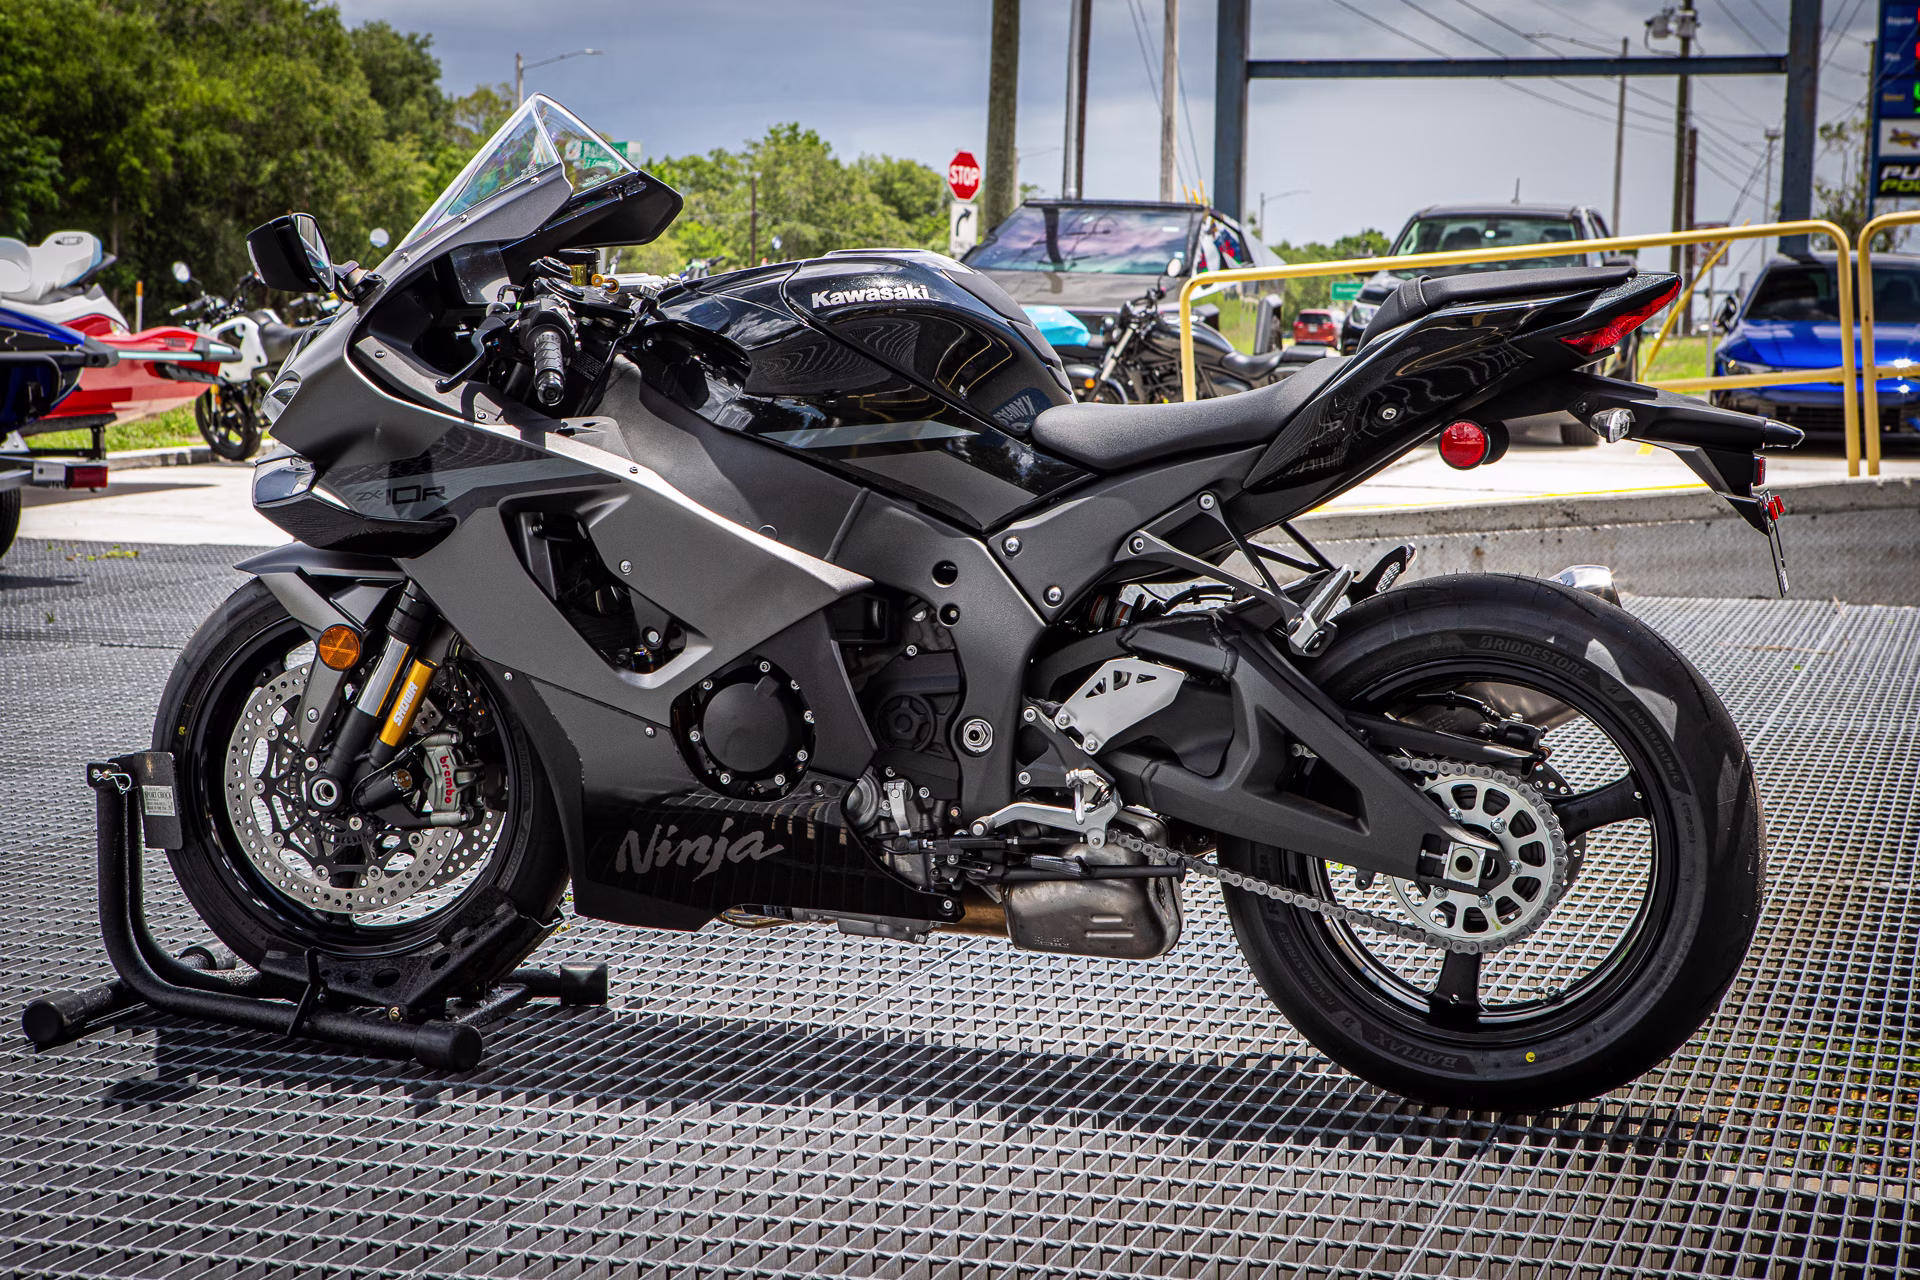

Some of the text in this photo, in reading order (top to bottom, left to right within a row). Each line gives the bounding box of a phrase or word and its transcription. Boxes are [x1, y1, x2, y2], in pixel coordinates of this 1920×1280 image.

[950, 164, 979, 187] STOP
[811, 284, 930, 309] Kawasaki
[355, 485, 448, 506] ZX-10R
[1479, 635, 1589, 679] BRIDGESTONE
[393, 681, 419, 727] SHOWA
[439, 755, 455, 804] brembo
[615, 817, 785, 882] Ninja
[1278, 931, 1336, 1006] RACING STREET
